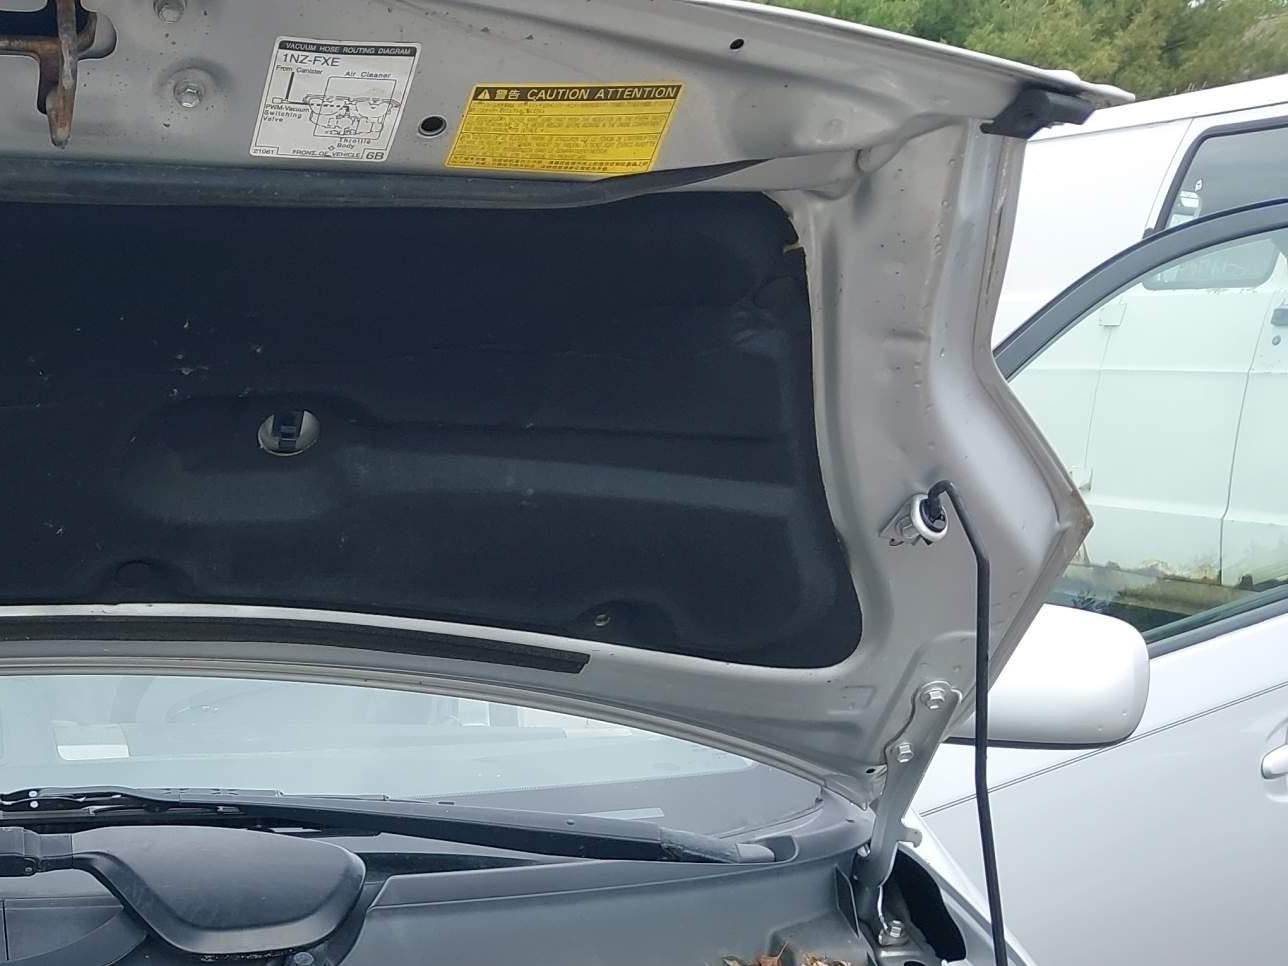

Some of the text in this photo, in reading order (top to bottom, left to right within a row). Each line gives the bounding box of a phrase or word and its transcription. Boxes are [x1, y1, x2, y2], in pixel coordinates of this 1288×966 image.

[285, 42, 412, 56] VACUUM HOSE ROUTING DIAGRAM
[281, 53, 342, 68] 1NZ-FXE
[526, 87, 590, 101] CAUTION
[595, 86, 677, 99] ATTENTION
